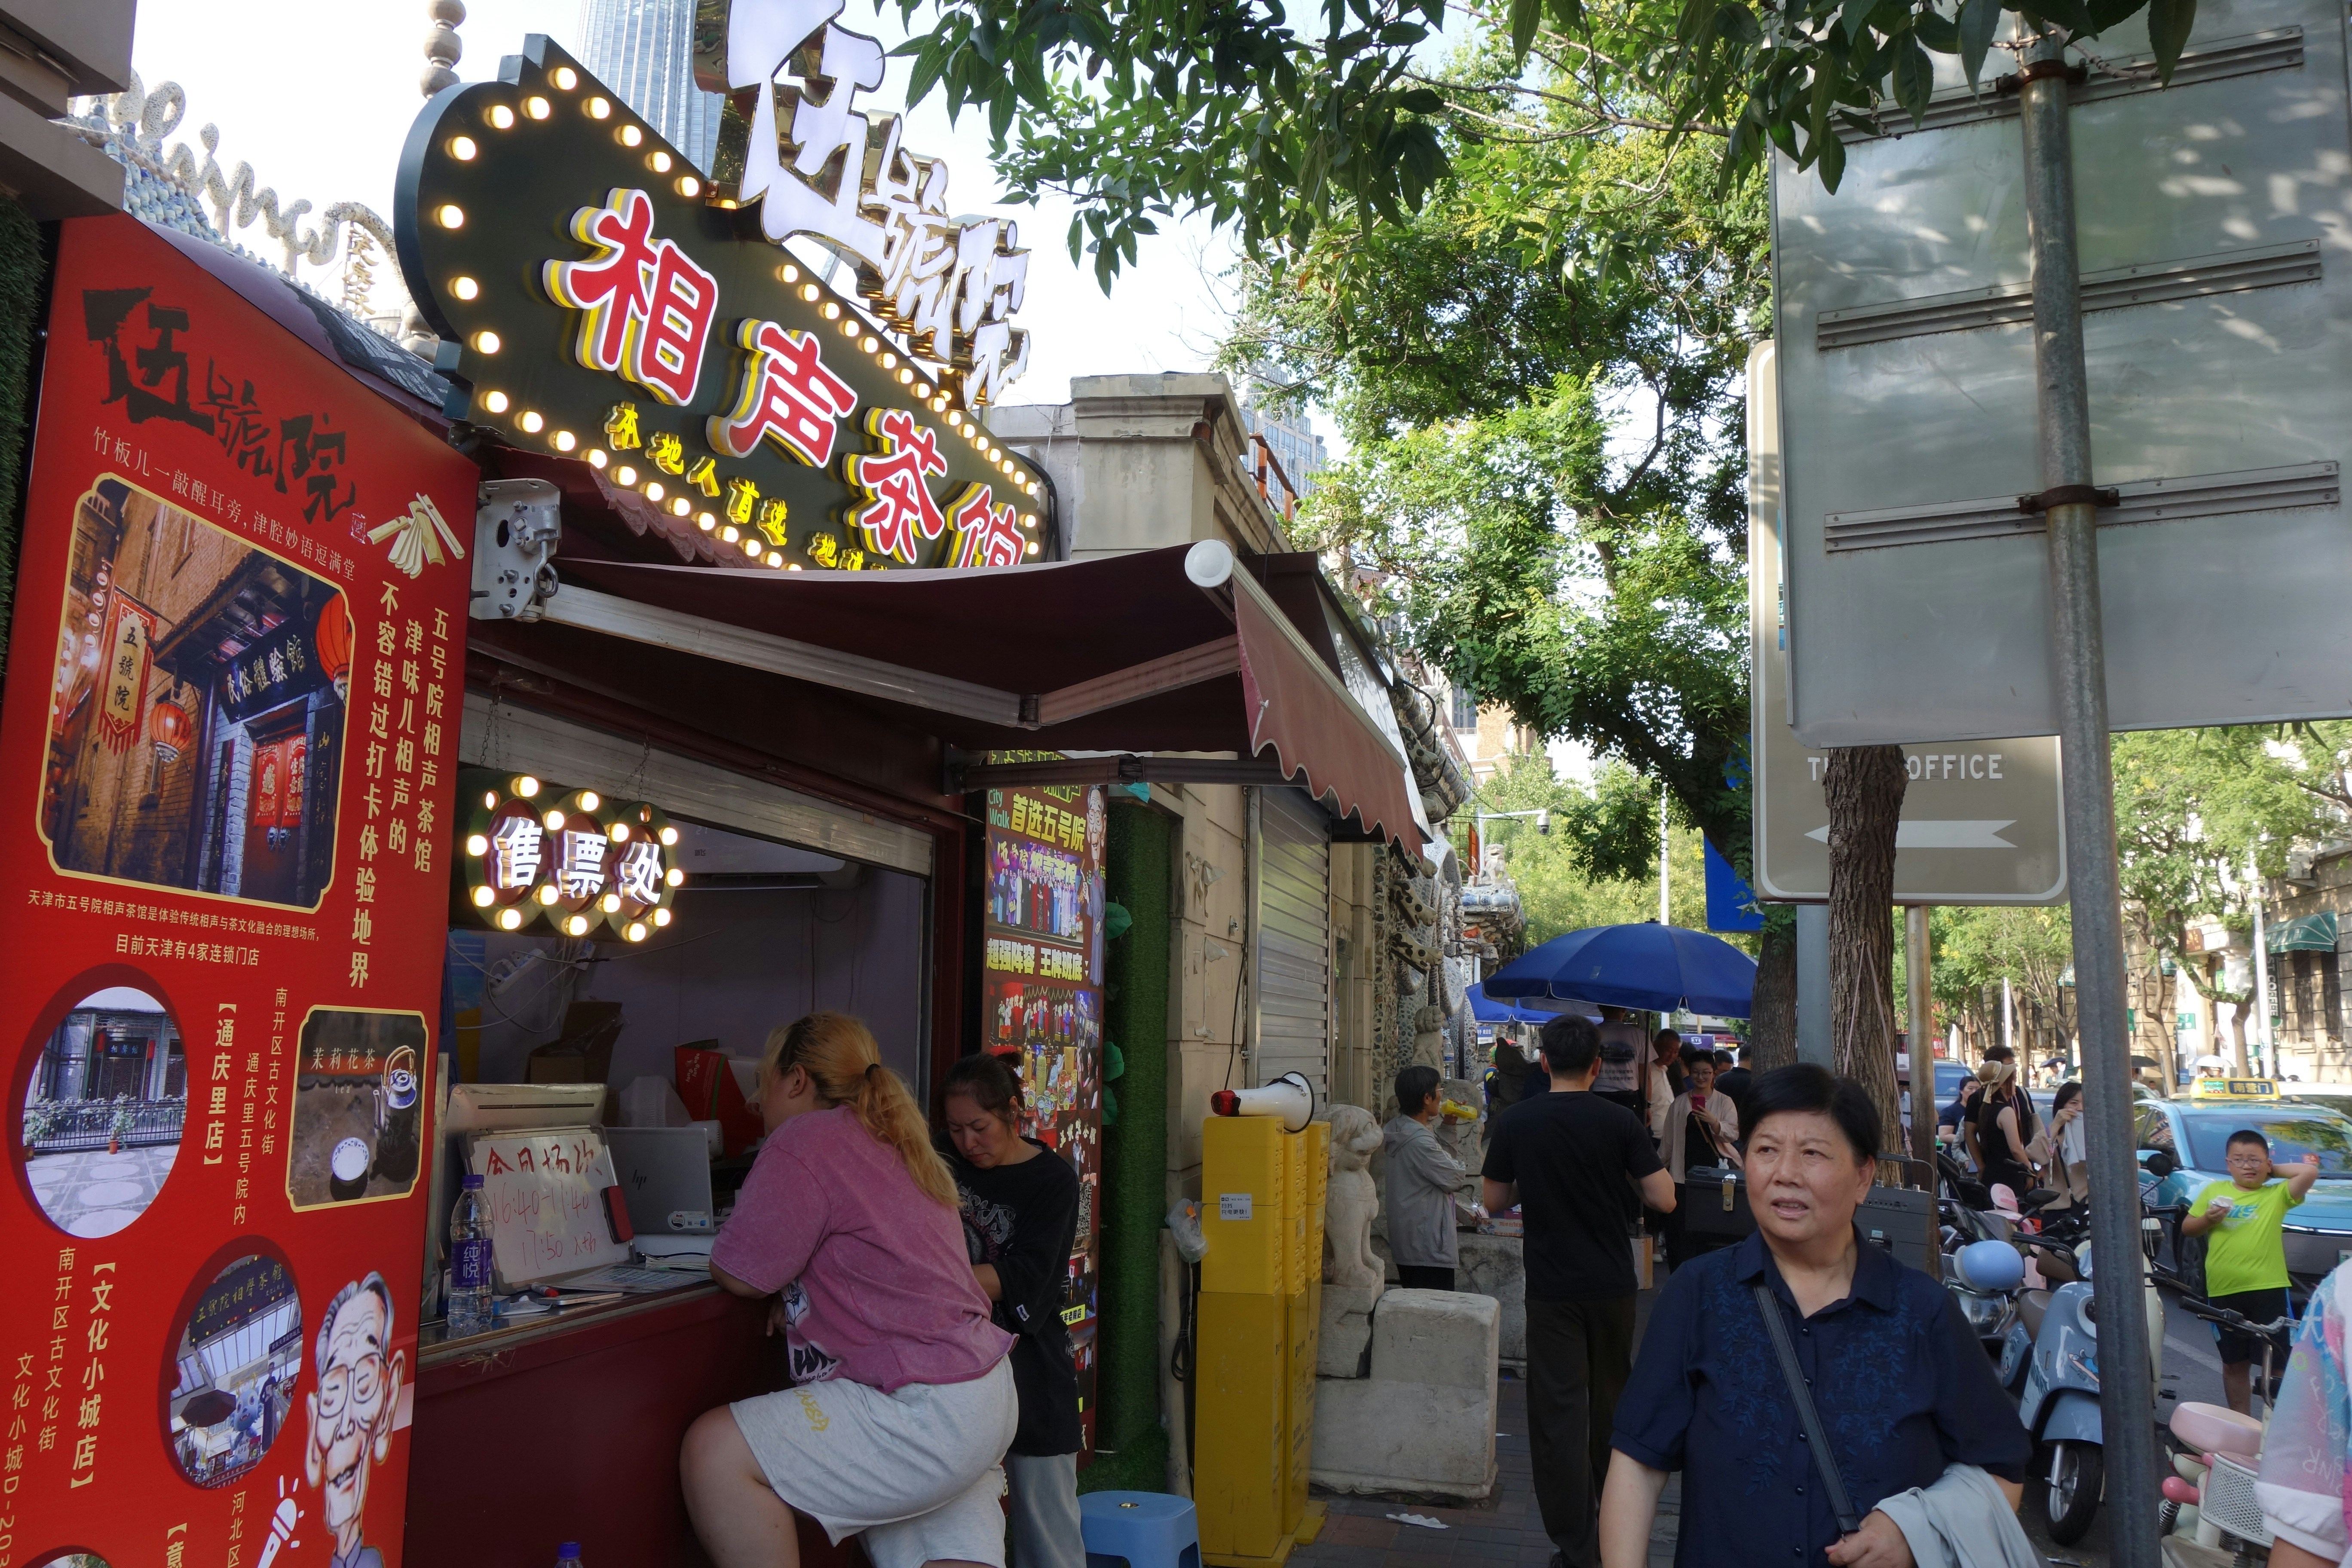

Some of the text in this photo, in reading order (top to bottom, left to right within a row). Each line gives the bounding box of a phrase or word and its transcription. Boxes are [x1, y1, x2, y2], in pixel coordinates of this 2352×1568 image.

[544, 188, 1026, 569] 相声茶馆
[604, 401, 888, 571] 本地人首选 地道
[114, 626, 138, 711] 五號院
[227, 634, 305, 704] 民俗體驗館
[388, 618, 423, 854] 津味儿相声的
[414, 607, 449, 873] 五号院相声茶馆
[1907, 754, 2003, 781] OFFICE
[349, 580, 399, 989] 不容错过打卡体验地界
[988, 788, 1003, 808] City
[989, 807, 1010, 829] Walk
[1011, 793, 1087, 852] 首选五号院
[492, 816, 664, 905] 售票处
[116, 934, 259, 966] 目前天津有4家连锁门店
[986, 938, 1083, 982] 超强阵容 王牌班底
[2267, 974, 2278, 1017] COFFEE
[204, 1003, 237, 1165] 【通庆里店】
[261, 987, 288, 1155] 南开区古文化街
[310, 1047, 376, 1070] 茉莉花茶
[2233, 1082, 2270, 1093] 南营门
[233, 1052, 260, 1225] 通庆里五号院内
[463, 1246, 479, 1279] 纯悦
[522, 1230, 563, 1270] 17:50
[39, 1246, 76, 1452] 南开区古文化街
[70, 1262, 116, 1488] 【文化小城店】
